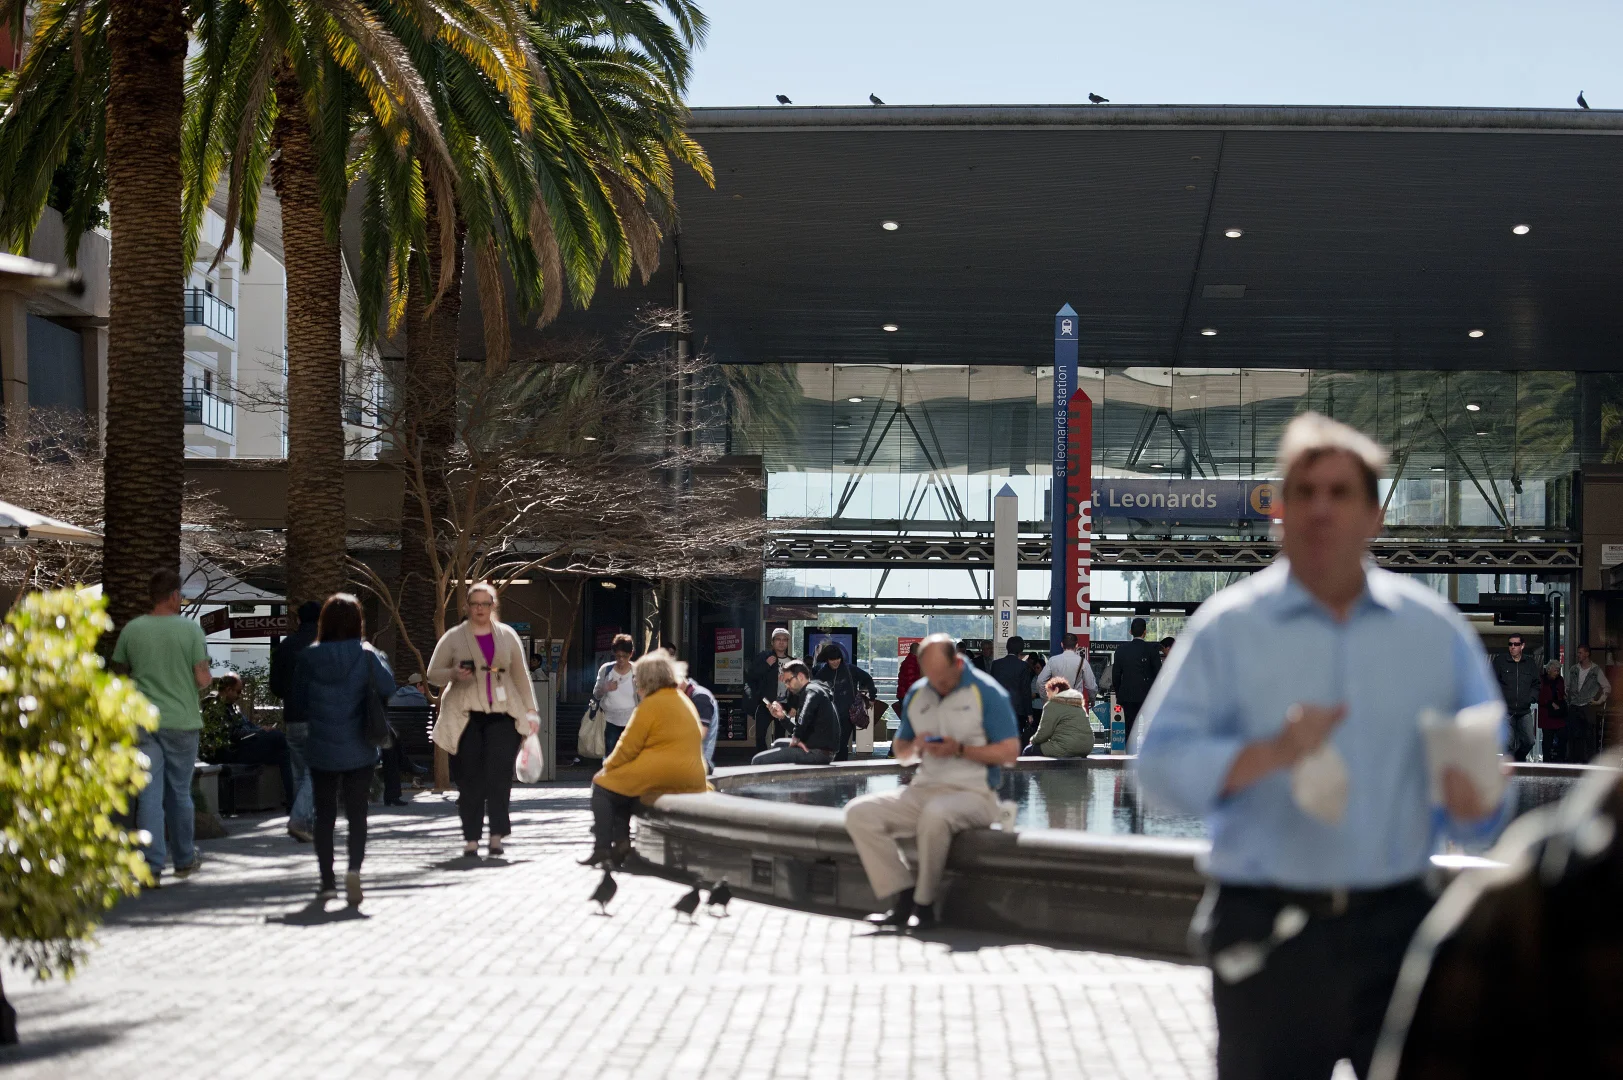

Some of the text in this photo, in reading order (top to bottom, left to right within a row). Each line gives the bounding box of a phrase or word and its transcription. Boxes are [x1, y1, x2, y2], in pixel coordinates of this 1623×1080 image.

[1055, 365, 1067, 477] st leonards station
[1091, 488, 1217, 508] t Leonards
[1105, 643, 1120, 651] you
